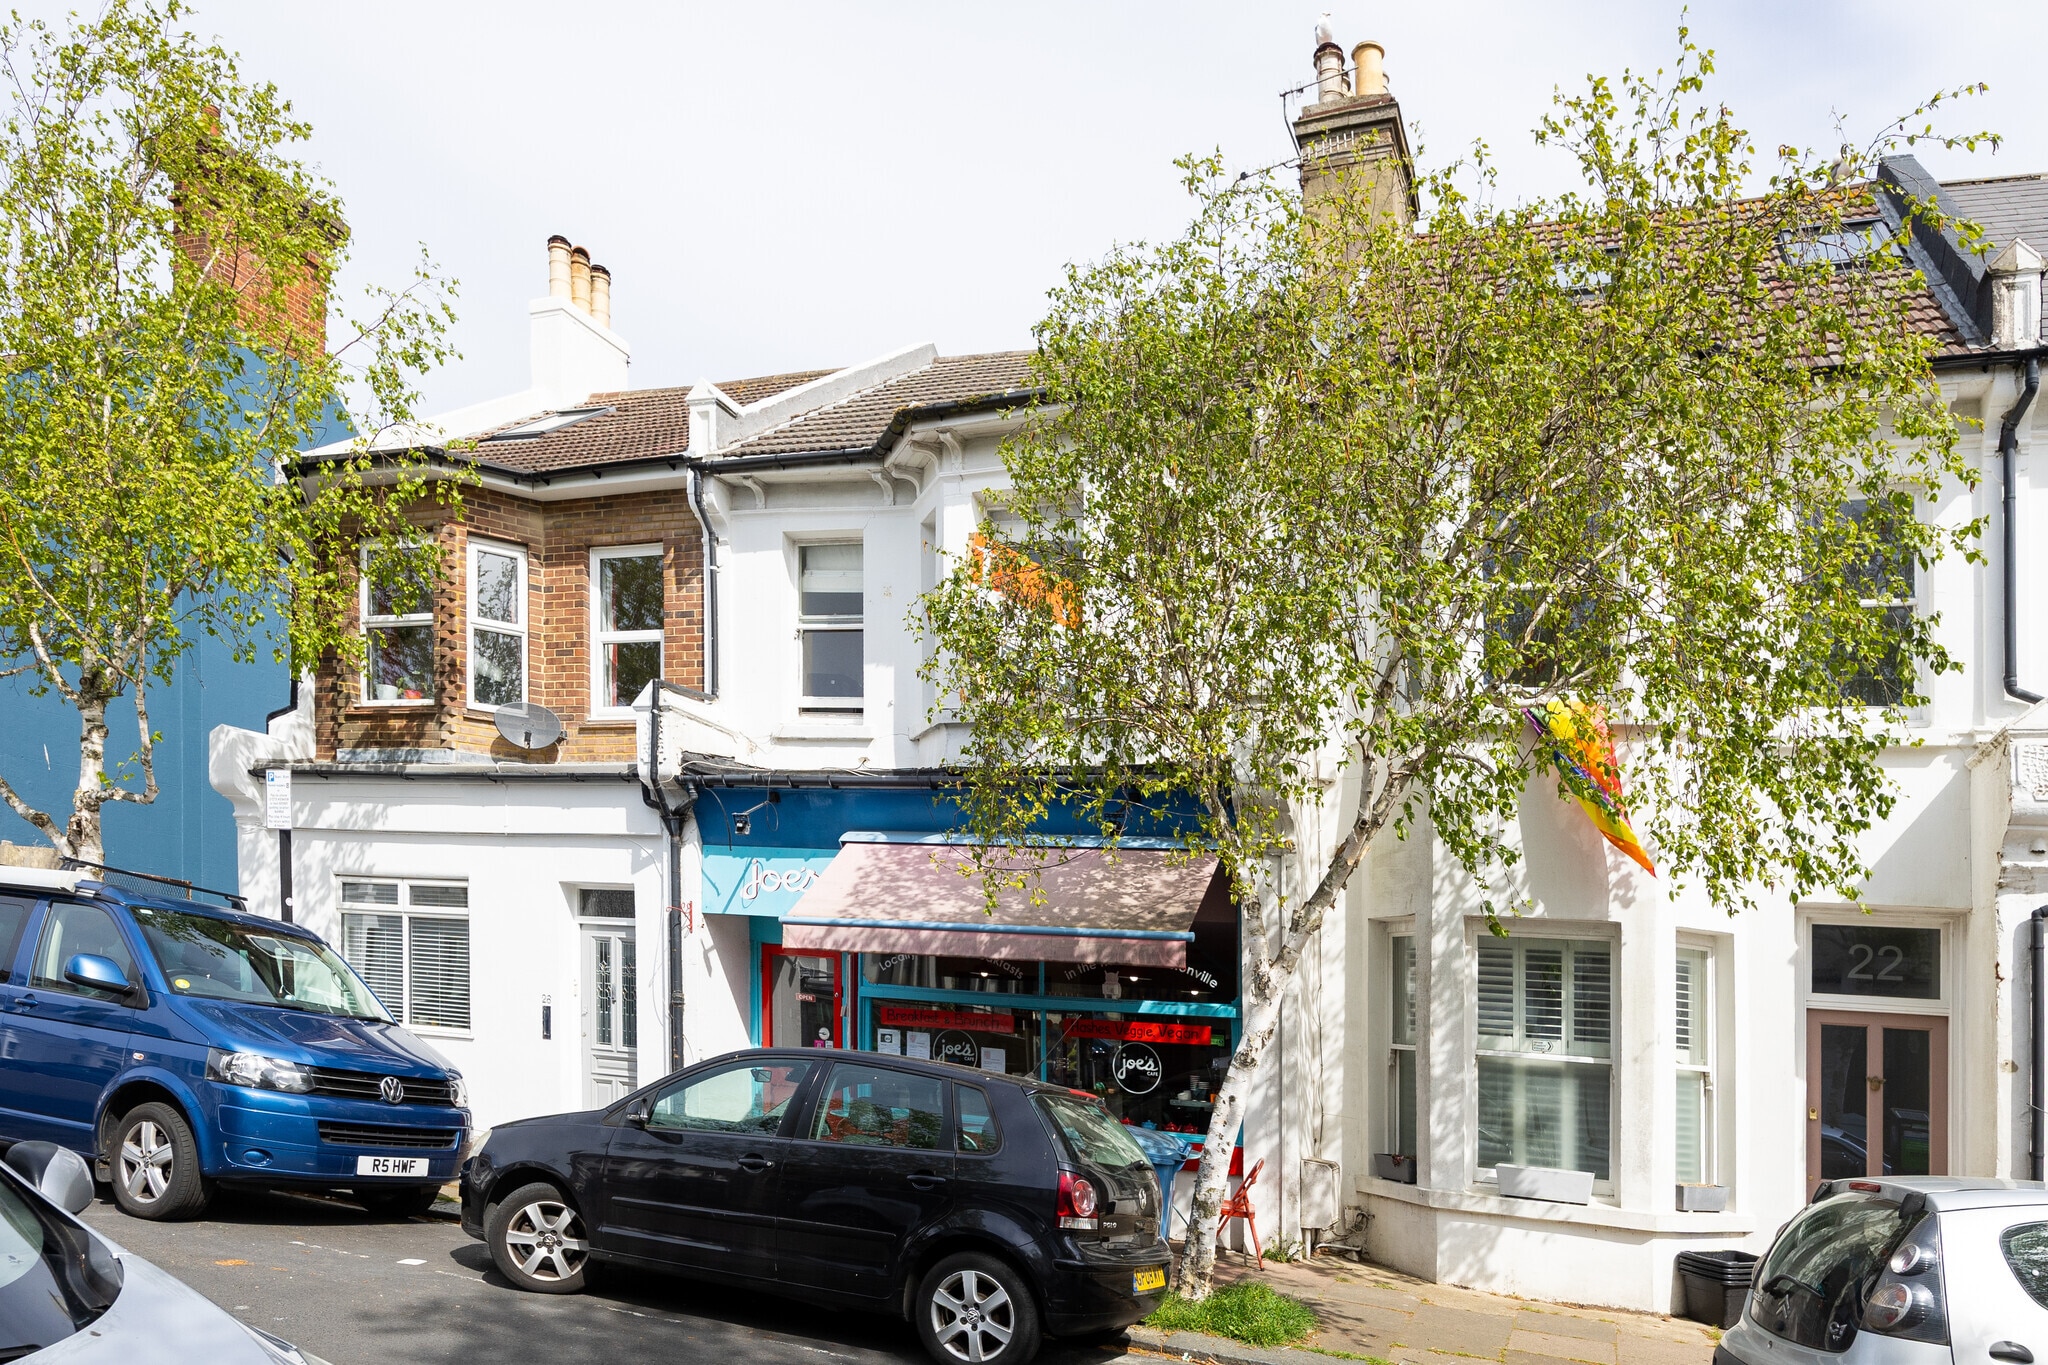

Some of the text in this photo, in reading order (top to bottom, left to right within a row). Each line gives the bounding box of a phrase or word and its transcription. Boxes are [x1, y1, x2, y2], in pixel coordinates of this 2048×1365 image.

[1847, 943, 1904, 981] 22
[886, 1008, 940, 1024] Breakfast
[954, 1012, 1001, 1030] Brunch
[1158, 1025, 1200, 1040] Vegan
[937, 1038, 975, 1063] joe's
[1117, 1052, 1159, 1080] joe's
[372, 1158, 417, 1174] R5 HWF
[1102, 1221, 1118, 1229] POLO
